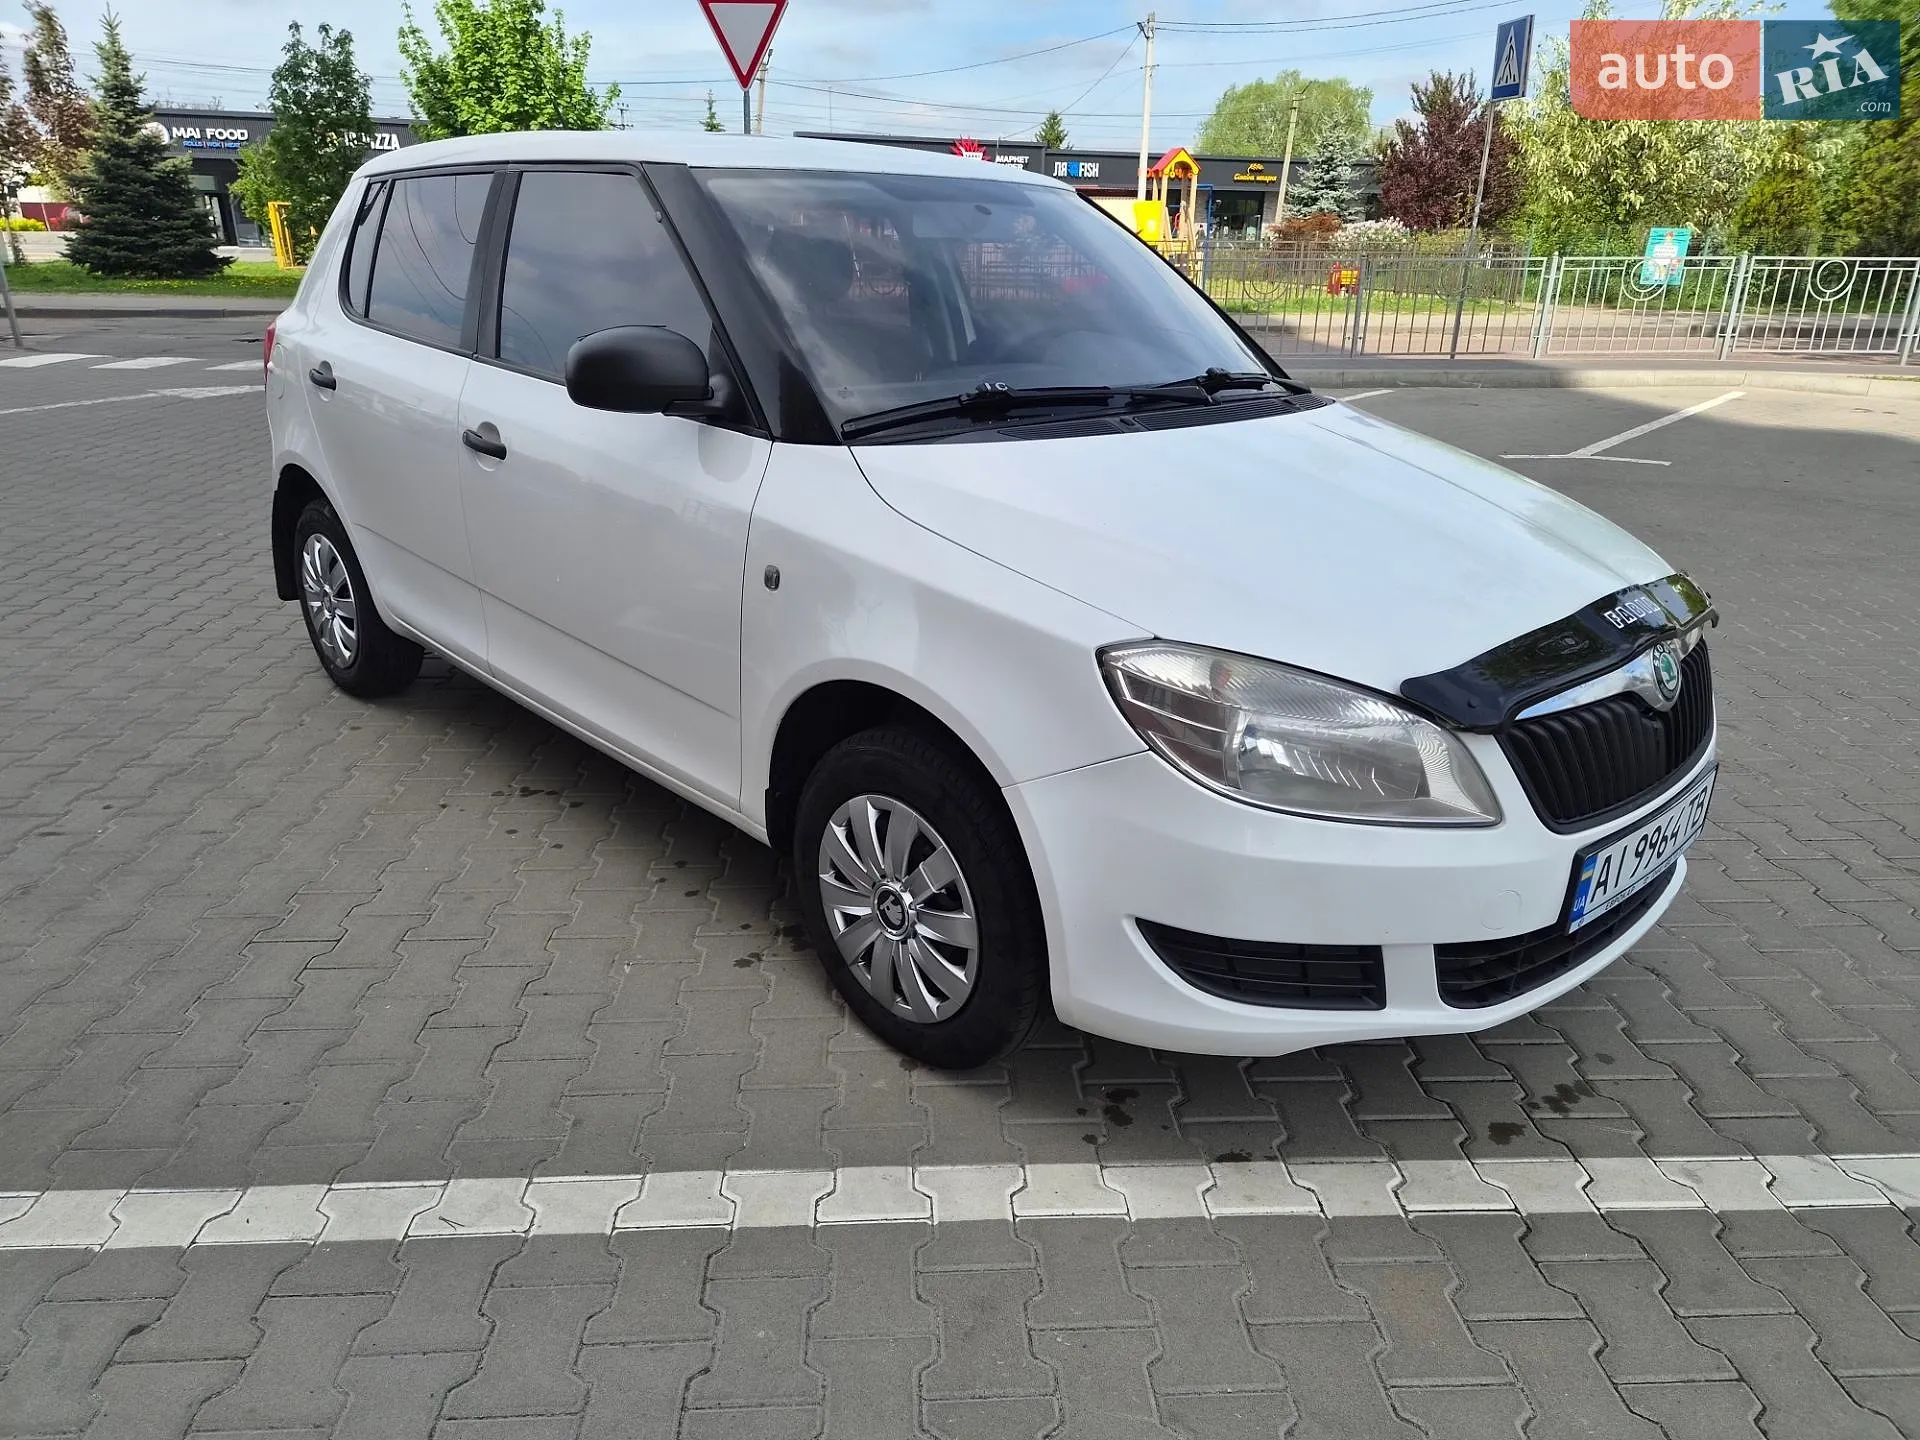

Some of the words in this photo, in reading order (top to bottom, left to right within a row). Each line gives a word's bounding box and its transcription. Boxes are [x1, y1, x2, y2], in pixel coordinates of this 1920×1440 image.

[172, 126, 201, 139] MAI
[205, 128, 249, 141] FOOD
[1078, 162, 1100, 178] FISH
[1589, 844, 1628, 904] AI
[1629, 805, 1685, 879] 9964
[1573, 895, 1587, 912] UA
